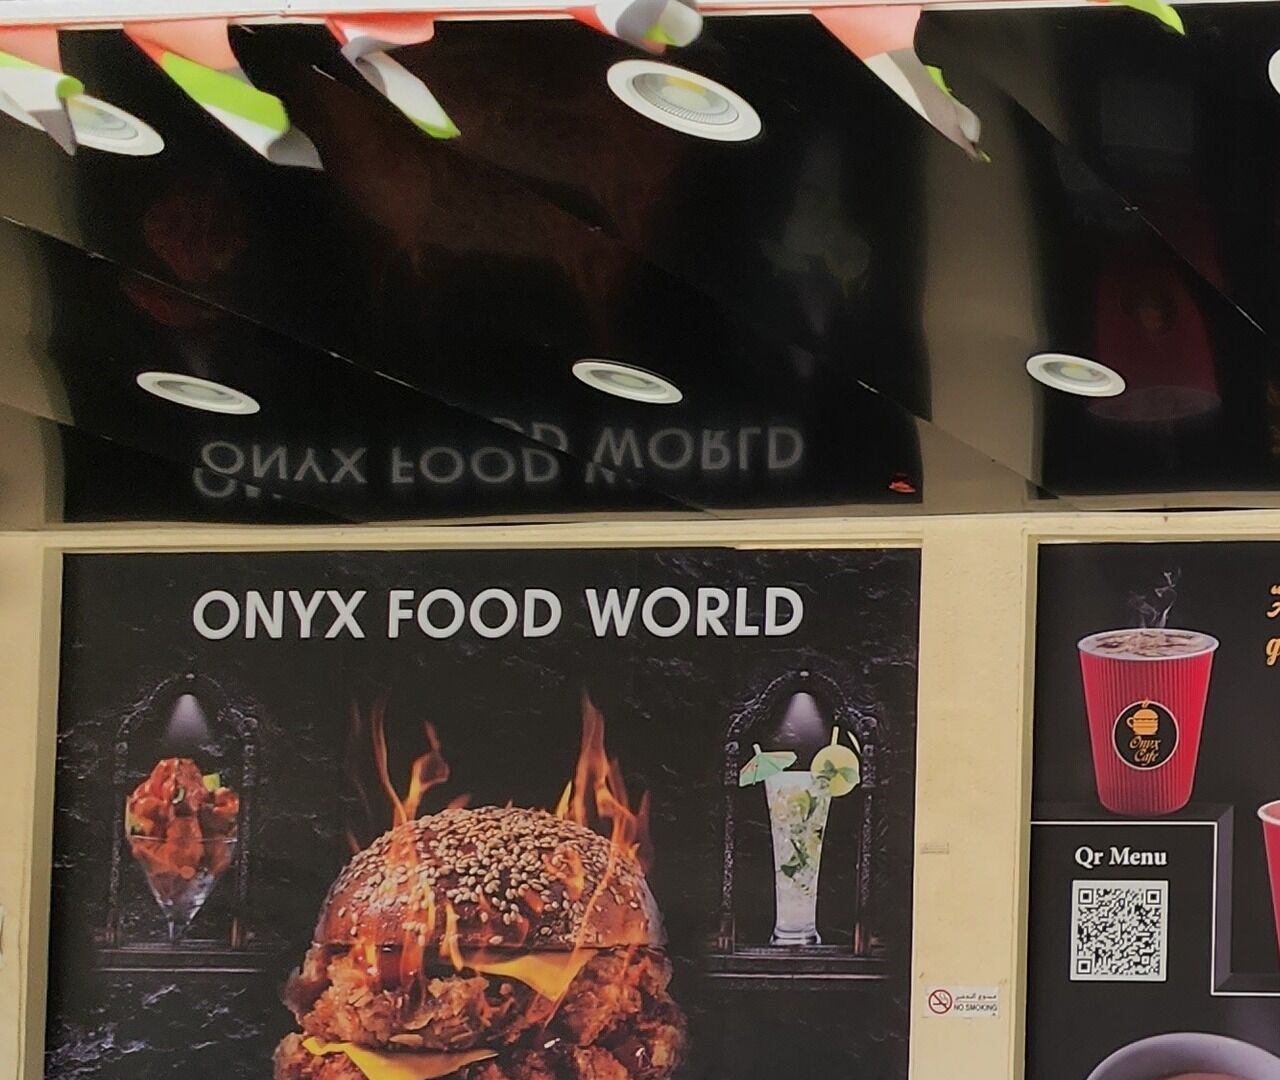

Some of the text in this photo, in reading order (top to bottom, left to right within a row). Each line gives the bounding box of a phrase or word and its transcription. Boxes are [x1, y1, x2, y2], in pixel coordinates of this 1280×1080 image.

[193, 586, 804, 640] ONYX FOOD WORLD
[1129, 735, 1162, 751] Onyx
[1074, 846, 1168, 870] Qr Menu
[954, 1003, 998, 1012] NO SMOKING
